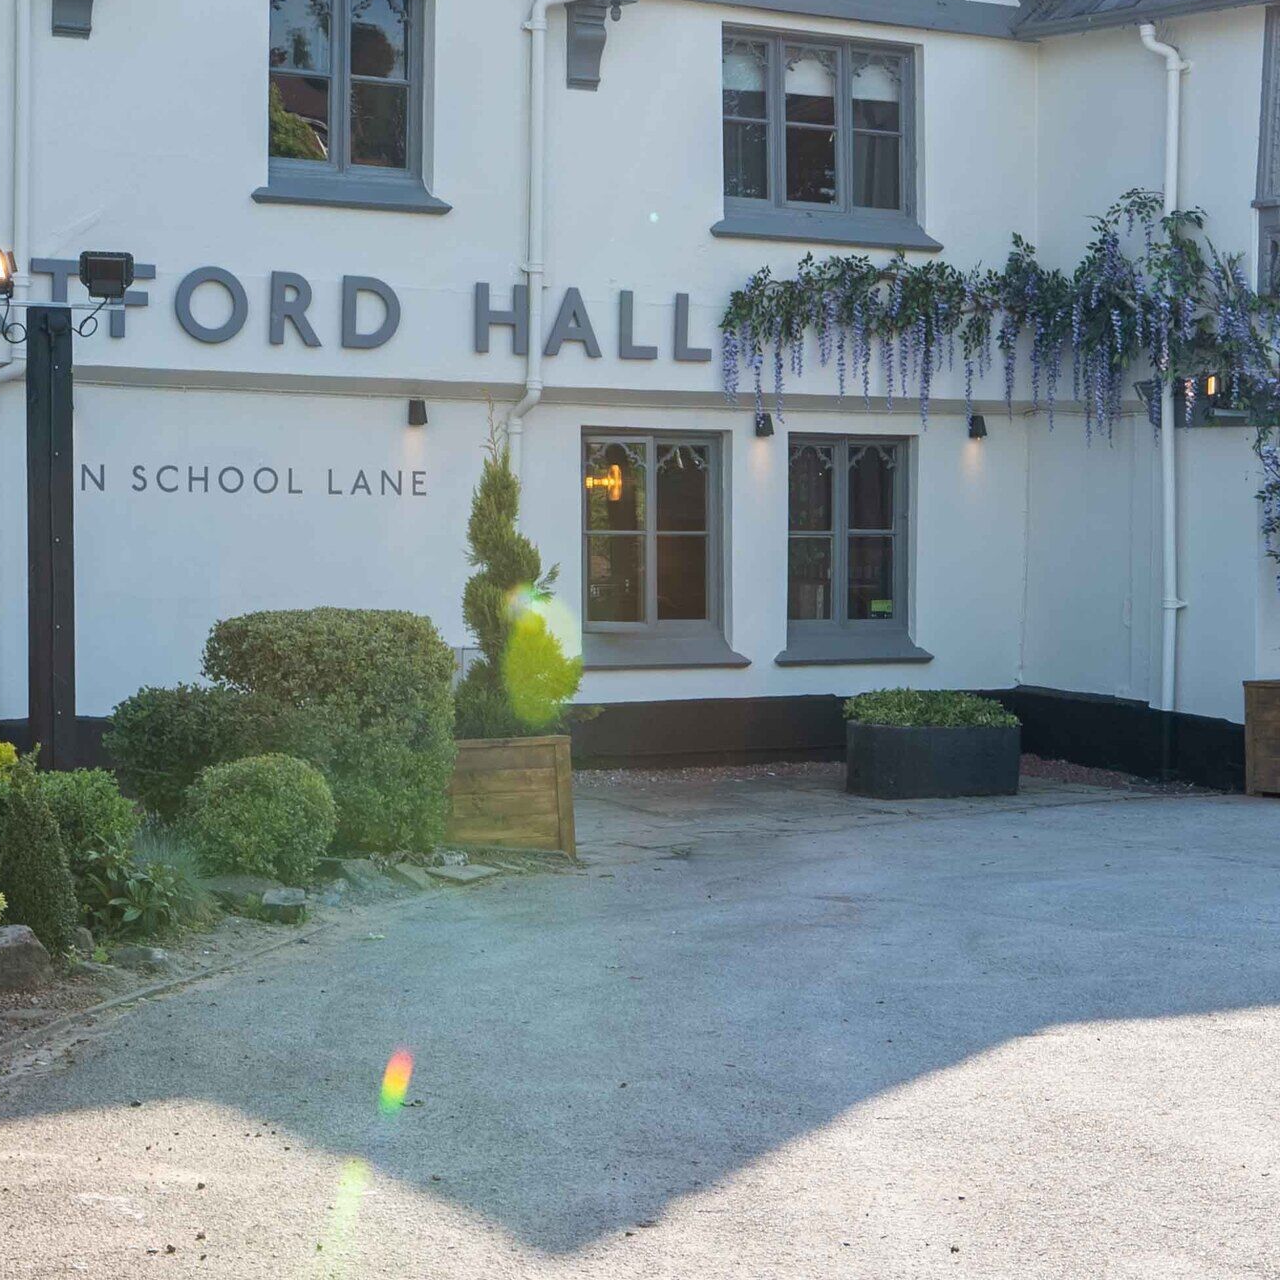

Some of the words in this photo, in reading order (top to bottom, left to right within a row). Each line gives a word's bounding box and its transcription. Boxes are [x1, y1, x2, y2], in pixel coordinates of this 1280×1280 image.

[474, 281, 712, 362] HALL
[131, 464, 304, 495] SCHOOL
[327, 468, 428, 497] LANE
